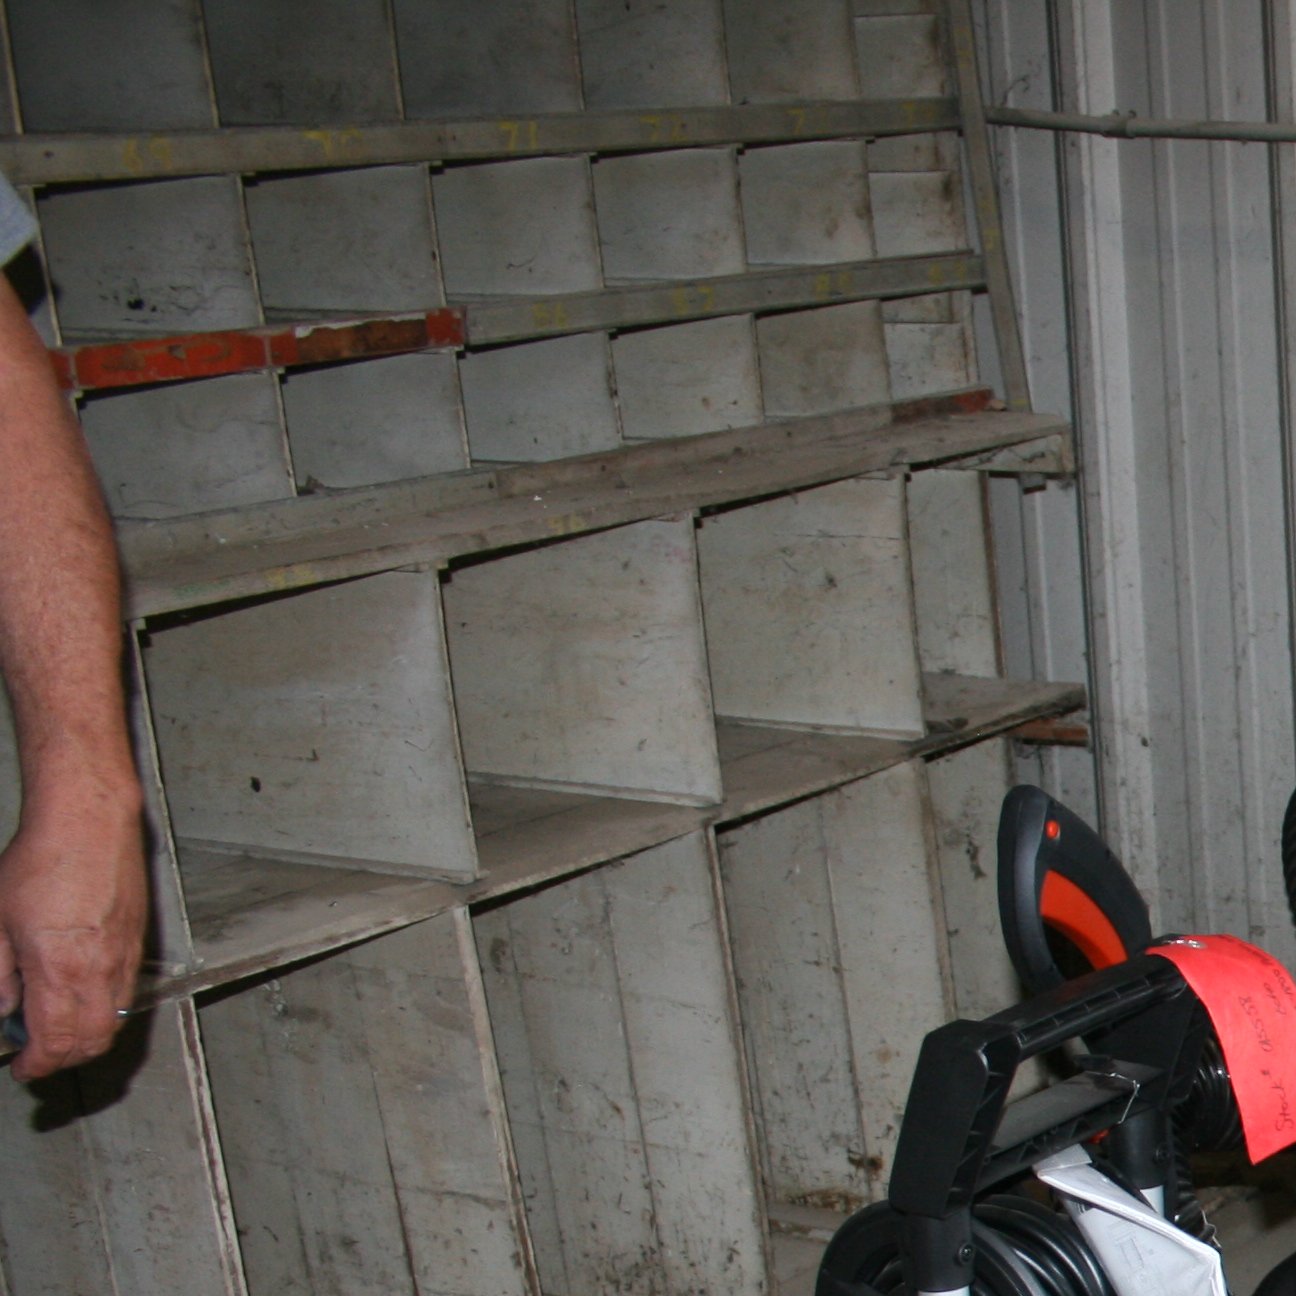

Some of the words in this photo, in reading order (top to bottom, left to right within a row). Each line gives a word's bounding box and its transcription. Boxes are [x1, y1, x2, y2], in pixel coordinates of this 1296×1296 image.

[498, 120, 539, 151] 71
[122, 136, 172, 172] 69
[1272, 1080, 1294, 1132] Stock
